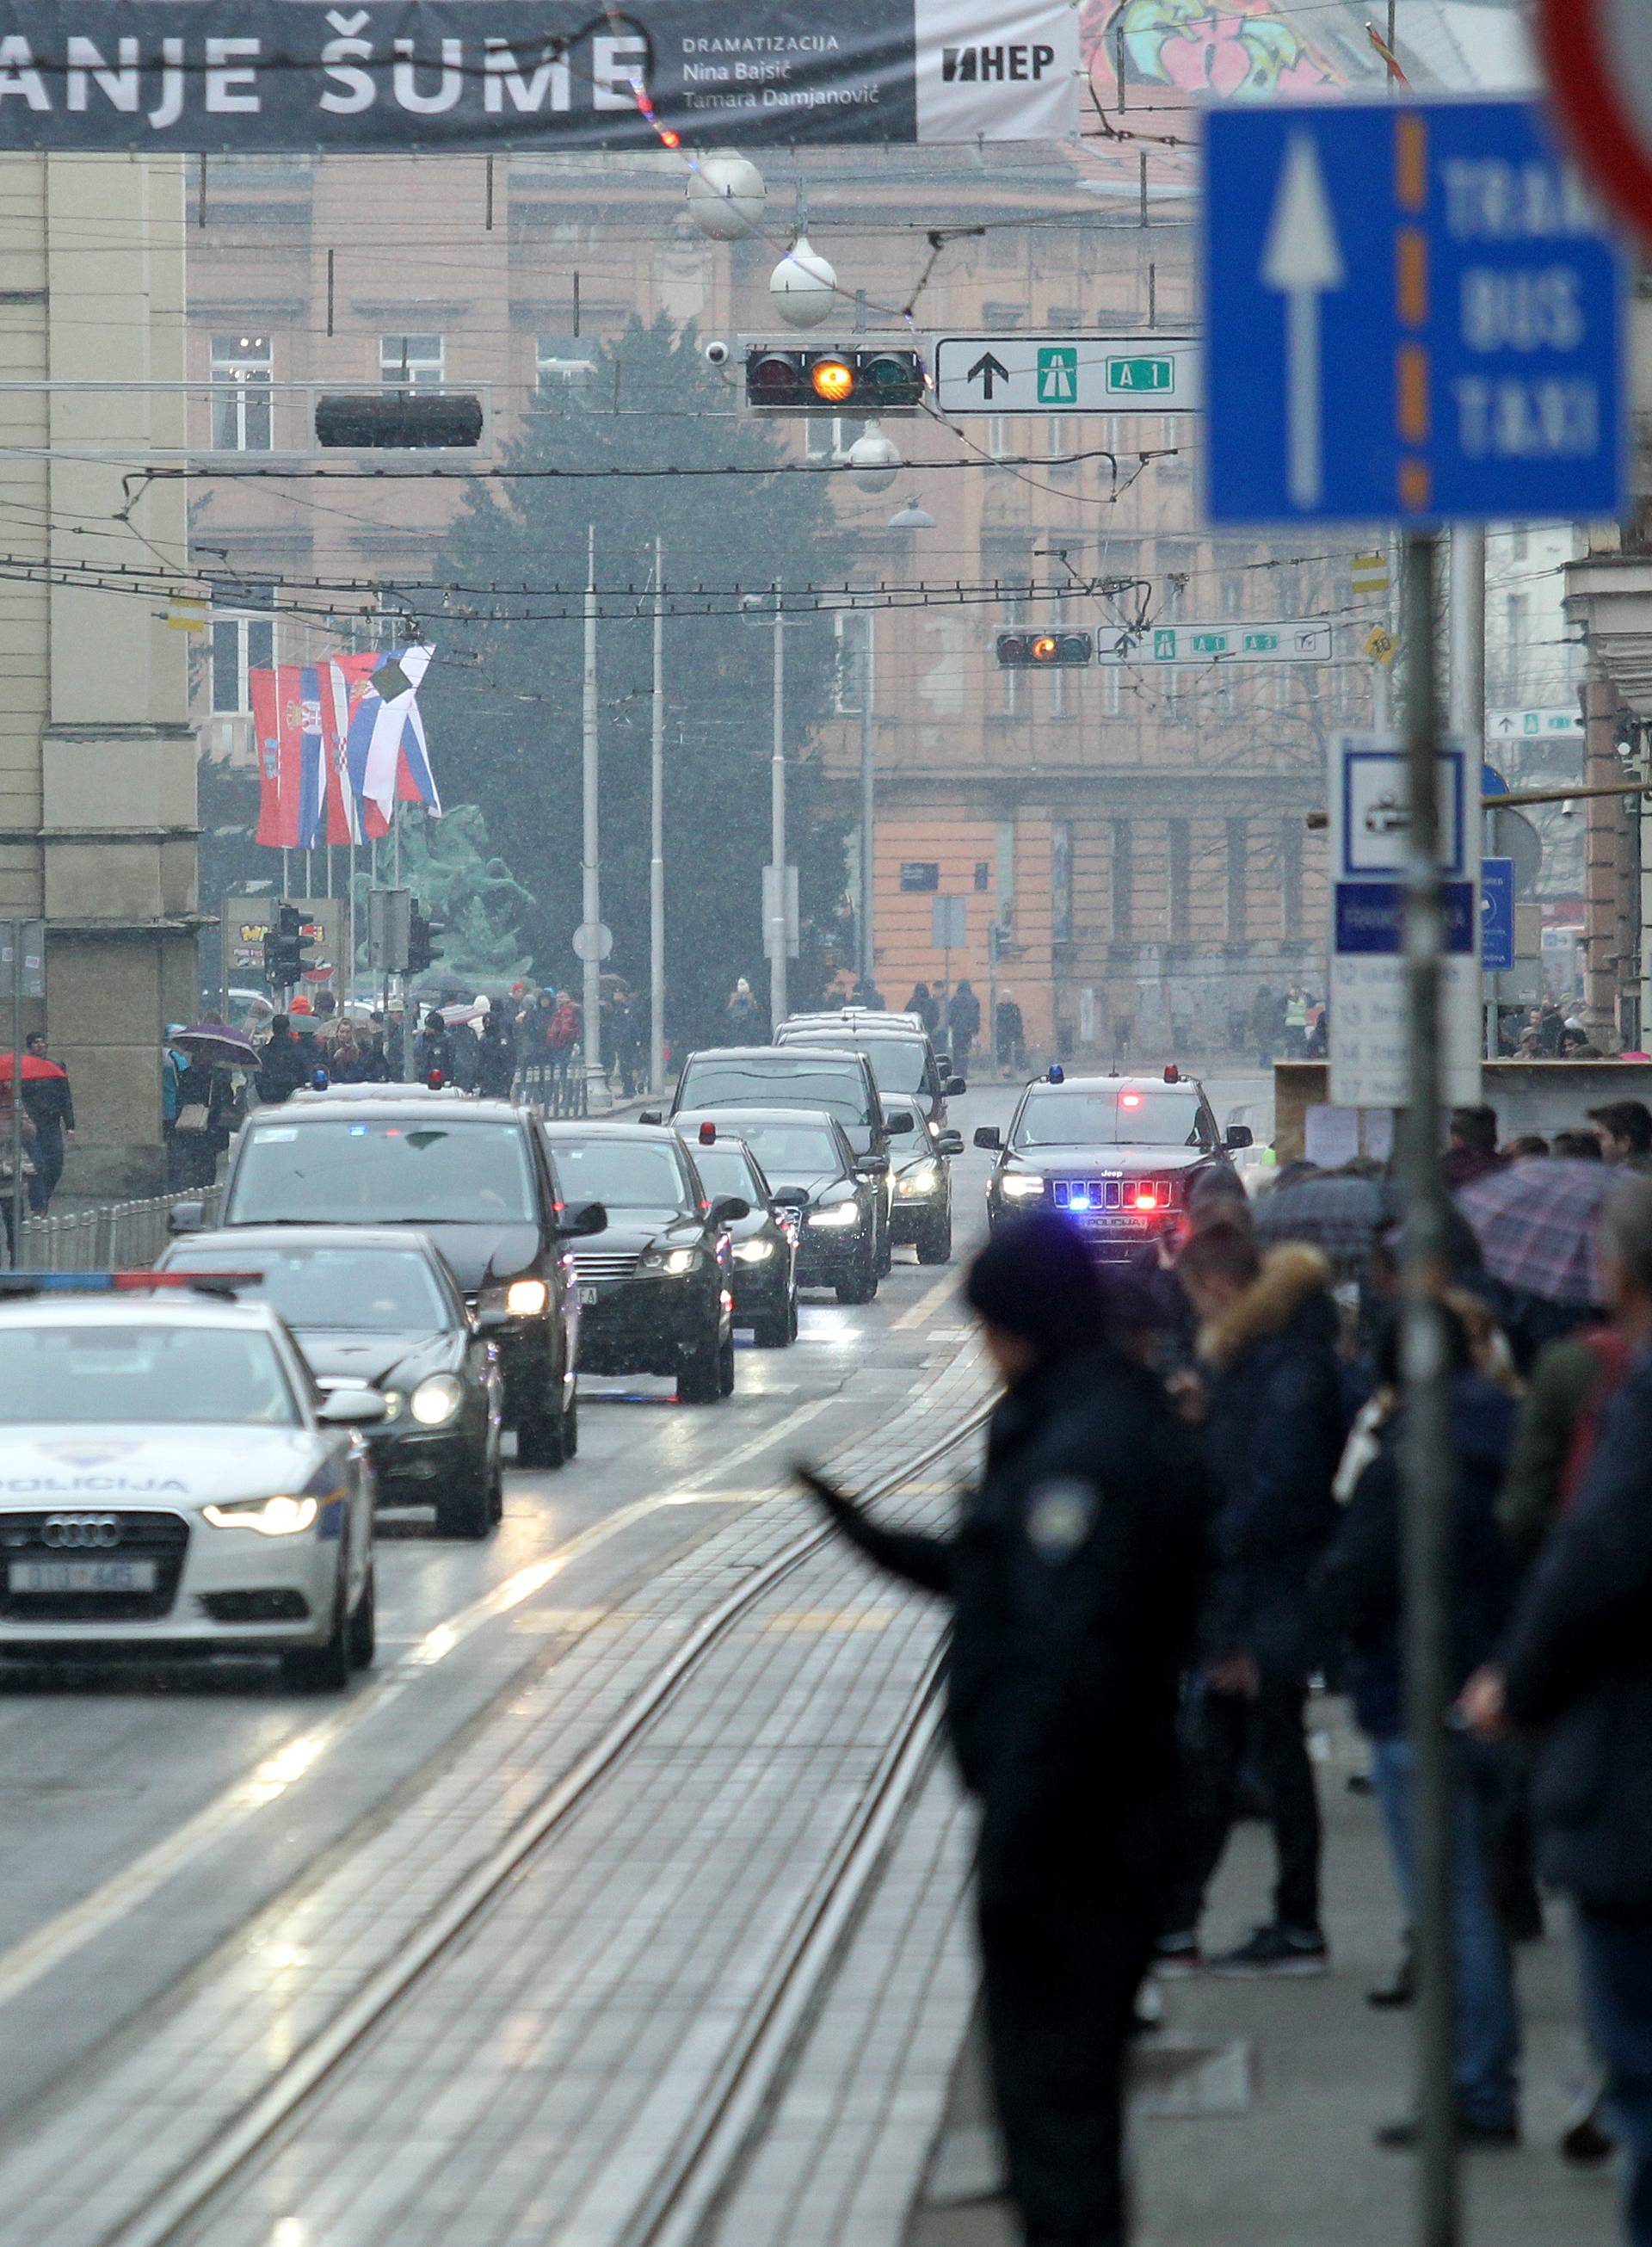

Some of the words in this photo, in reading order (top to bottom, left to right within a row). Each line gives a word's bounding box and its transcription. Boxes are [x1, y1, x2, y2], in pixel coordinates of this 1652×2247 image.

[682, 35, 840, 53] DRAMATIZACIJA
[319, 10, 645, 113] ŠUME
[683, 62, 730, 82] Nina
[981, 46, 1054, 81] HEP
[683, 90, 756, 108] Tamara
[762, 84, 879, 110] Damjanović
[1462, 267, 1586, 353] BUS
[1120, 363, 1133, 386] A
[1151, 363, 1158, 386] 1
[1453, 374, 1600, 460] TAXI
[0, 1478, 189, 1493] OLICIJA
